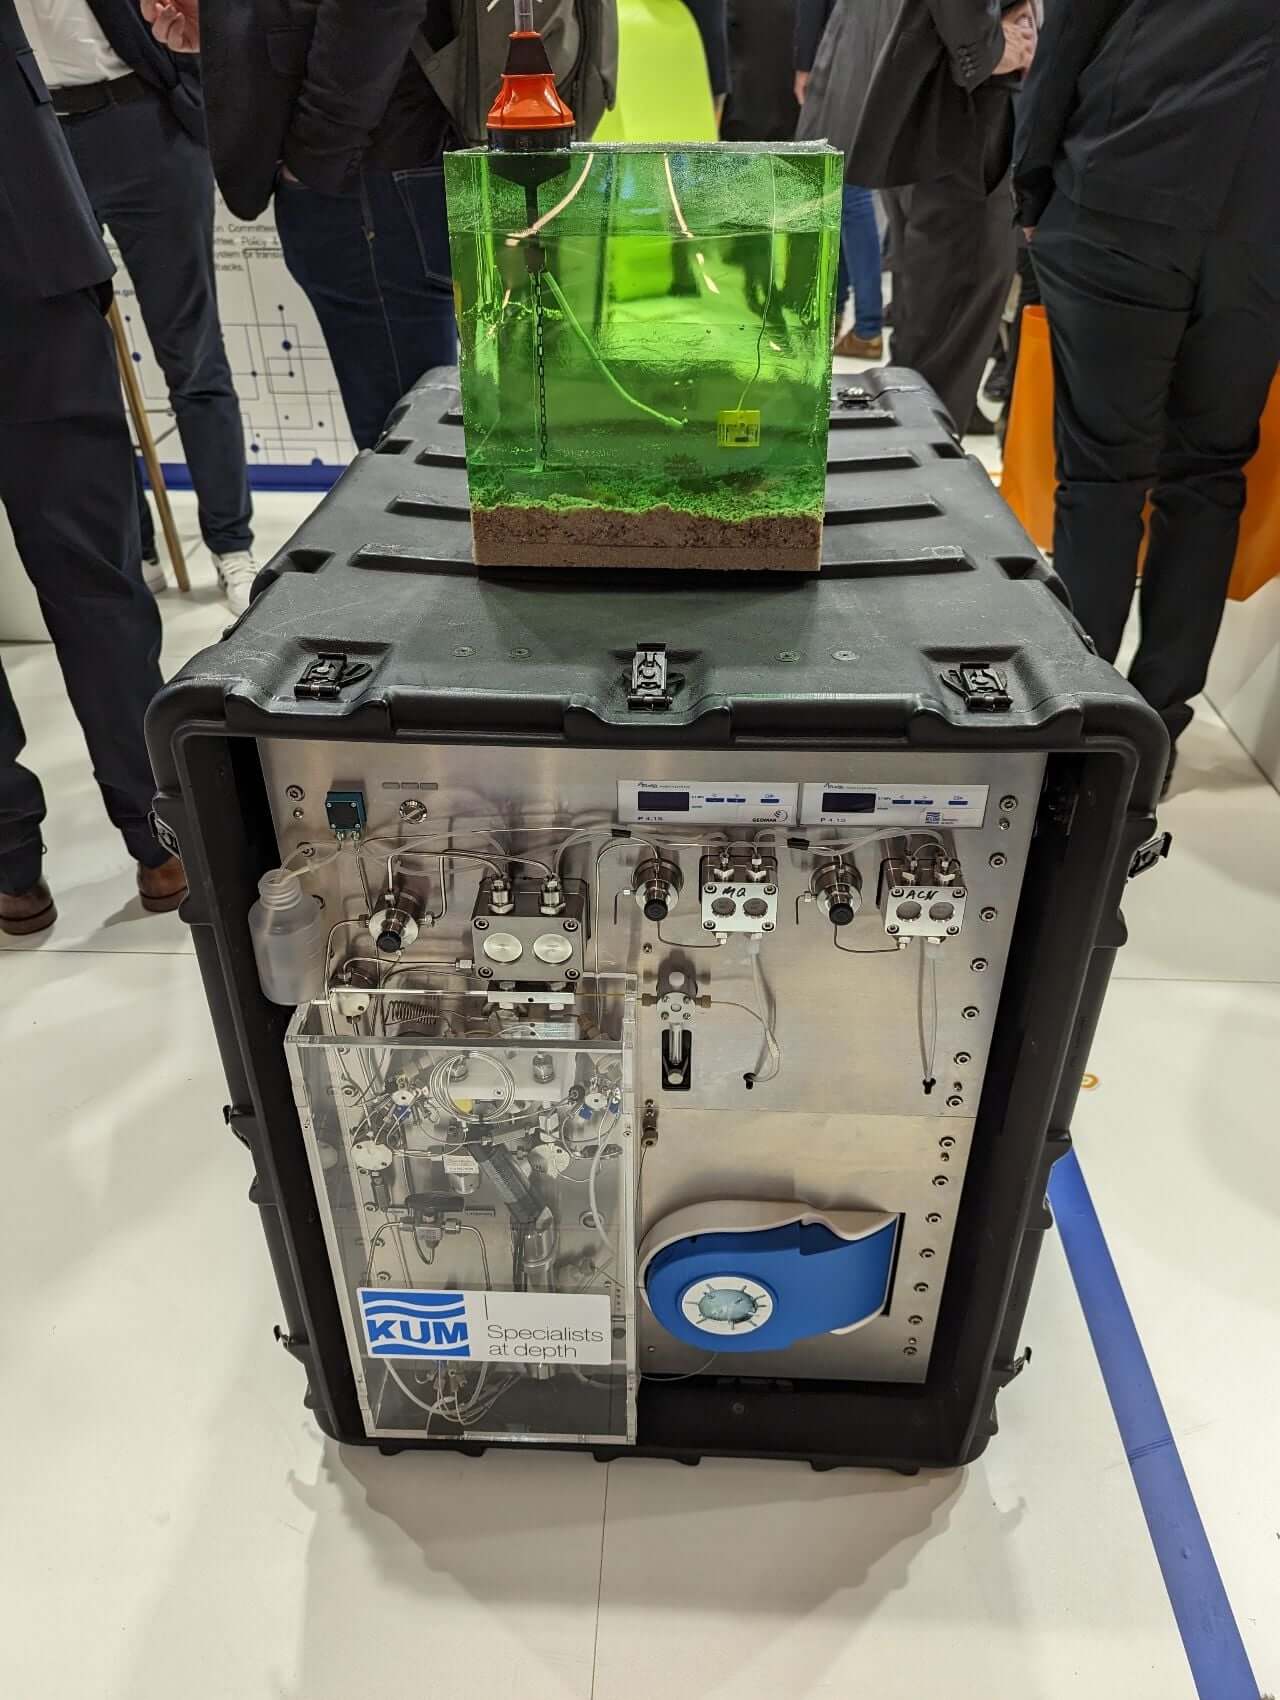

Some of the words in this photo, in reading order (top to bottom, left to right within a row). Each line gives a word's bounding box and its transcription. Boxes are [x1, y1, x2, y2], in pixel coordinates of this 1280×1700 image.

[367, 1319, 469, 1345] KUM
[487, 1323, 604, 1343] Specialists
[489, 1343, 509, 1356] at
[513, 1343, 577, 1360] depth
